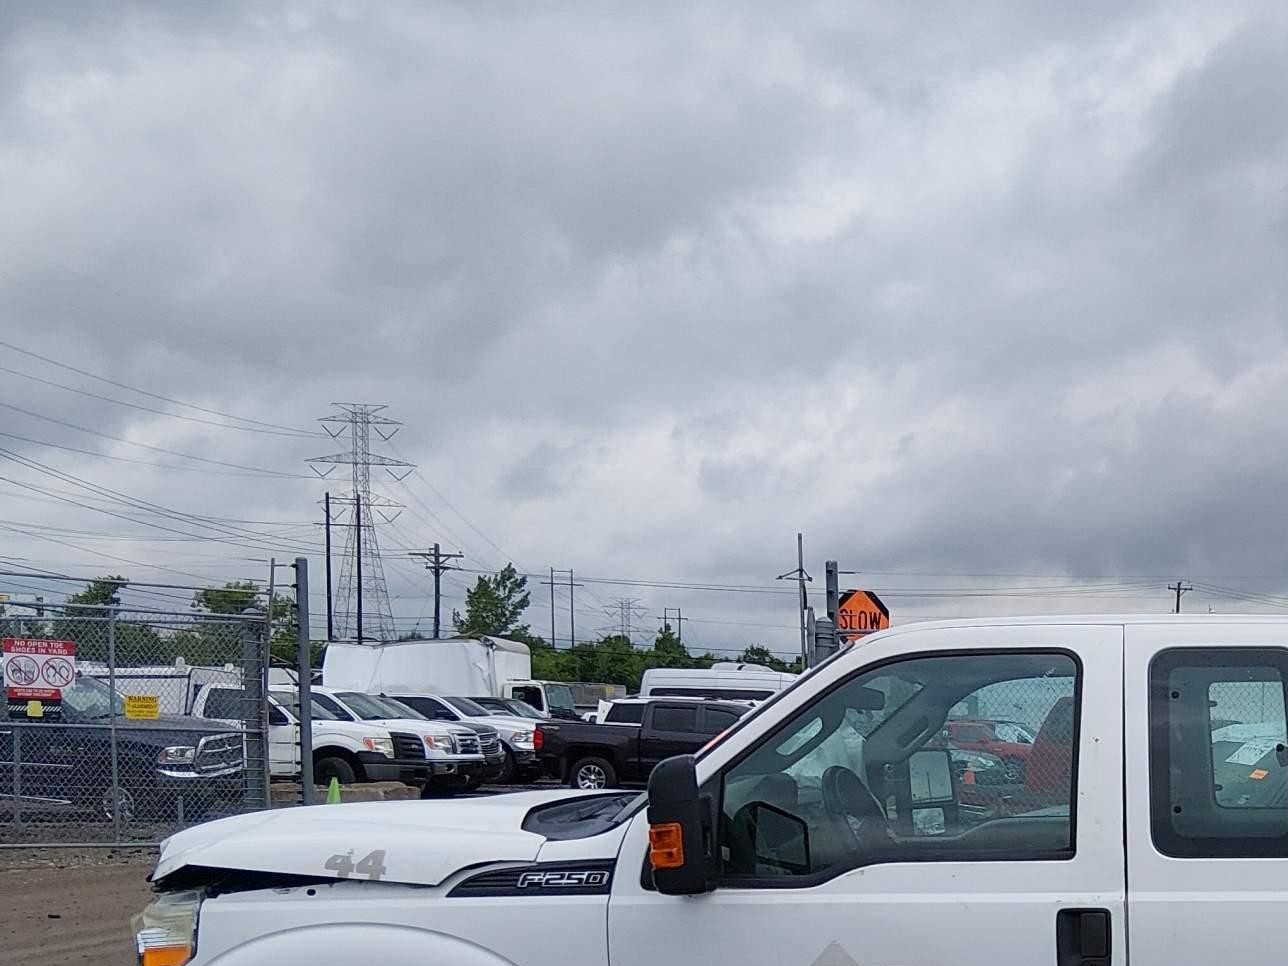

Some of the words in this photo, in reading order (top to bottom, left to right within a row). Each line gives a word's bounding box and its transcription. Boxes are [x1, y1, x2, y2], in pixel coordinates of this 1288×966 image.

[840, 608, 881, 630] SLOW
[127, 695, 157, 703] WARNING
[324, 849, 387, 880] 44
[516, 871, 610, 888] F-250
